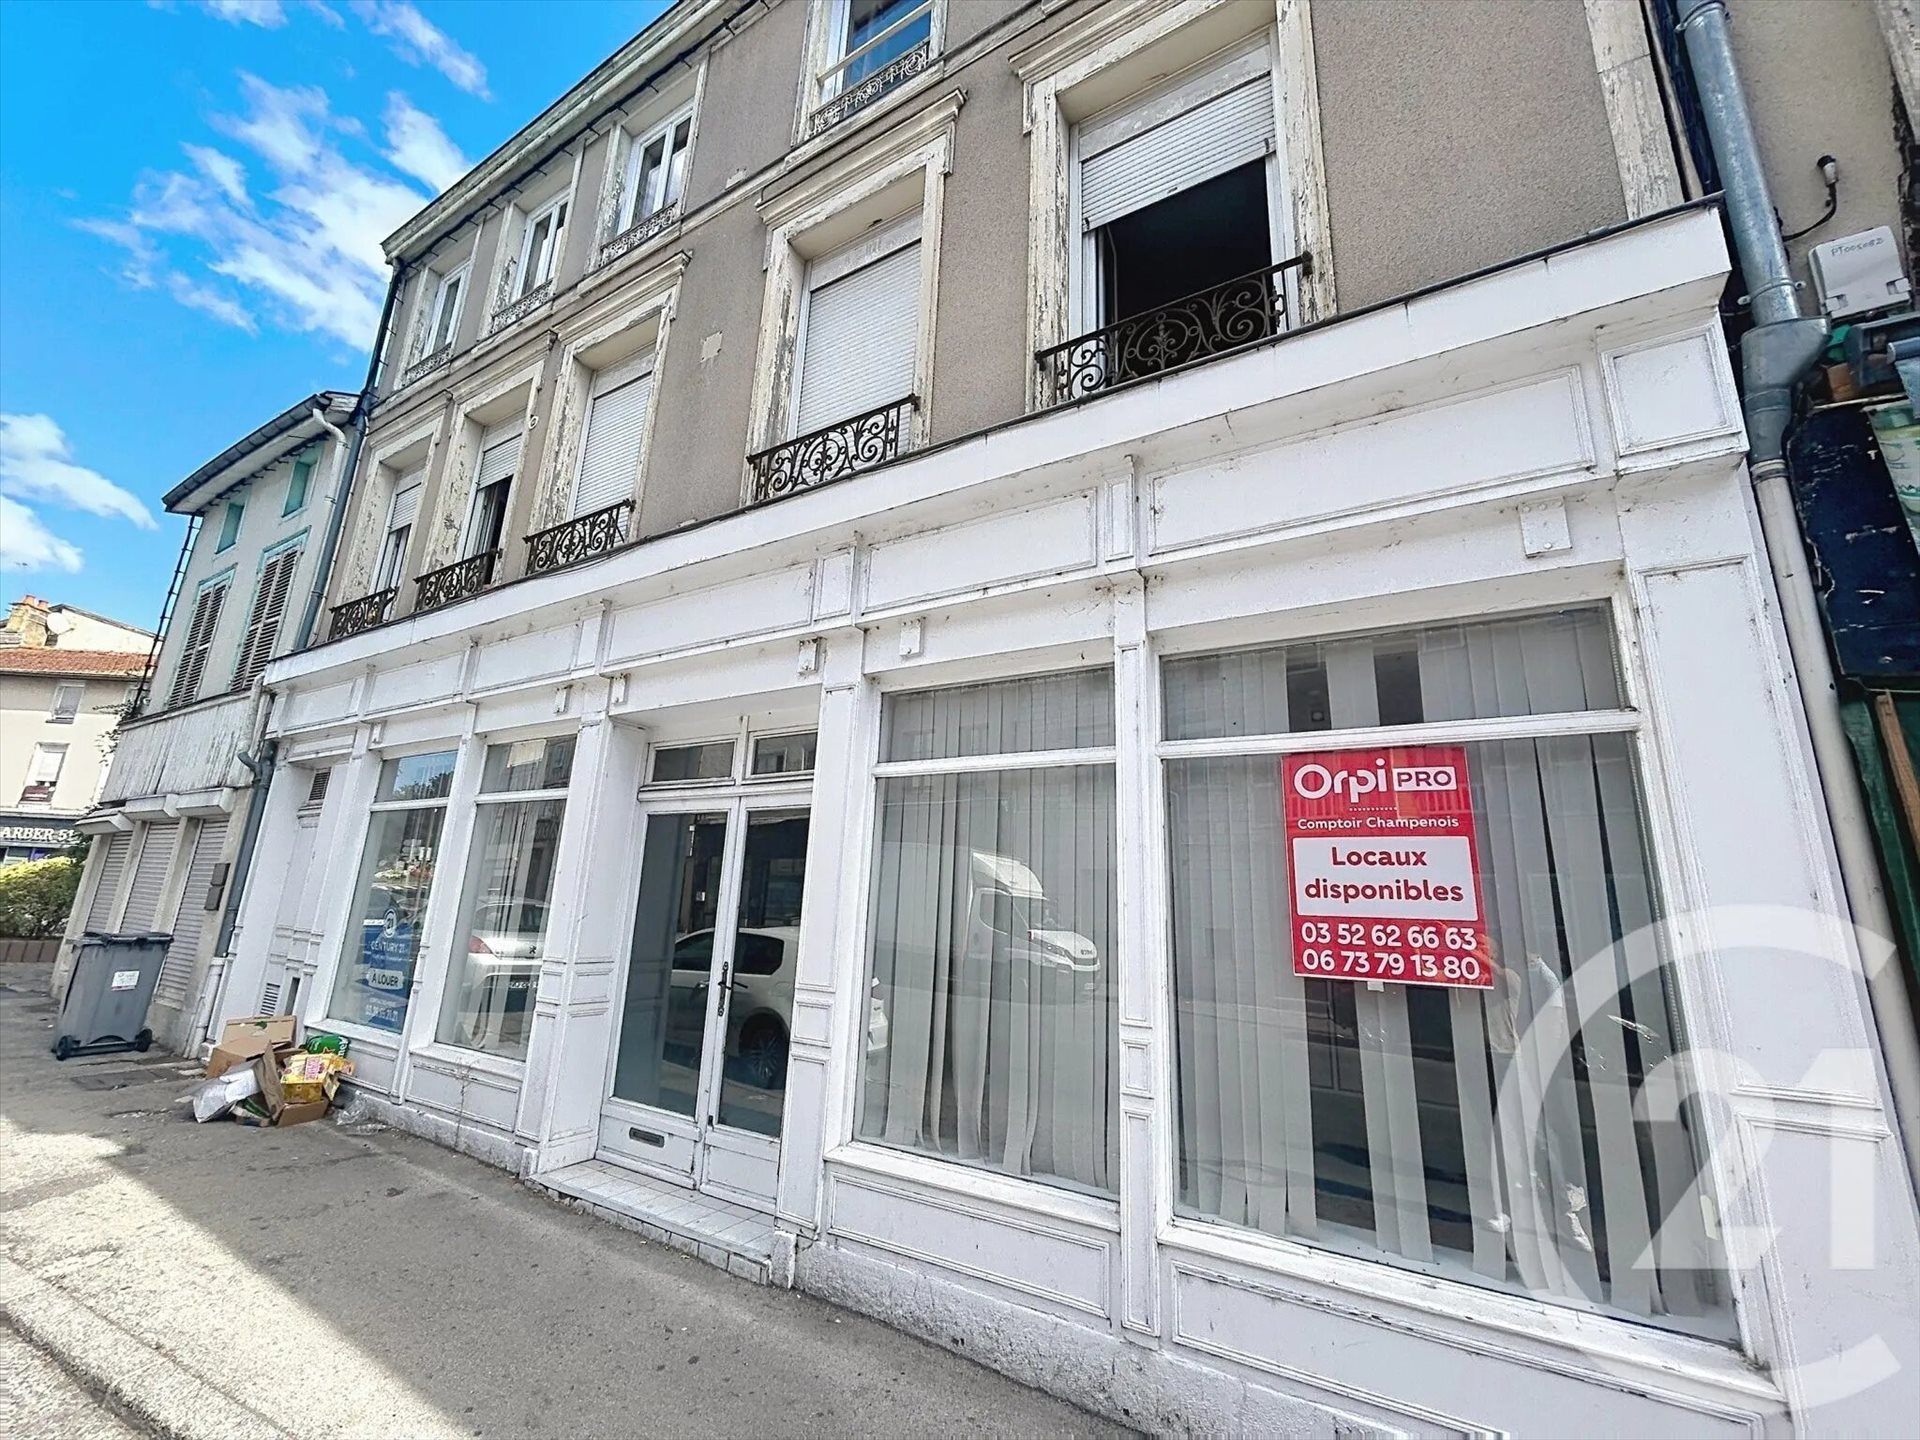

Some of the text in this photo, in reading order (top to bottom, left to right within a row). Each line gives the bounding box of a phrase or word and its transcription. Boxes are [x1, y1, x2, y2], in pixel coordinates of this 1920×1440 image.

[1293, 758, 1452, 803] Orpi PRO
[0, 826, 55, 841] ARBER
[1297, 816, 1460, 831] Comptoir Champenois
[1331, 847, 1428, 867] Locaux
[1304, 878, 1465, 904] disponibles
[1301, 922, 1478, 951] 03 52 62 66 63
[1302, 948, 1481, 980] 06 73 79 13 80
[378, 974, 399, 987] LOUER
